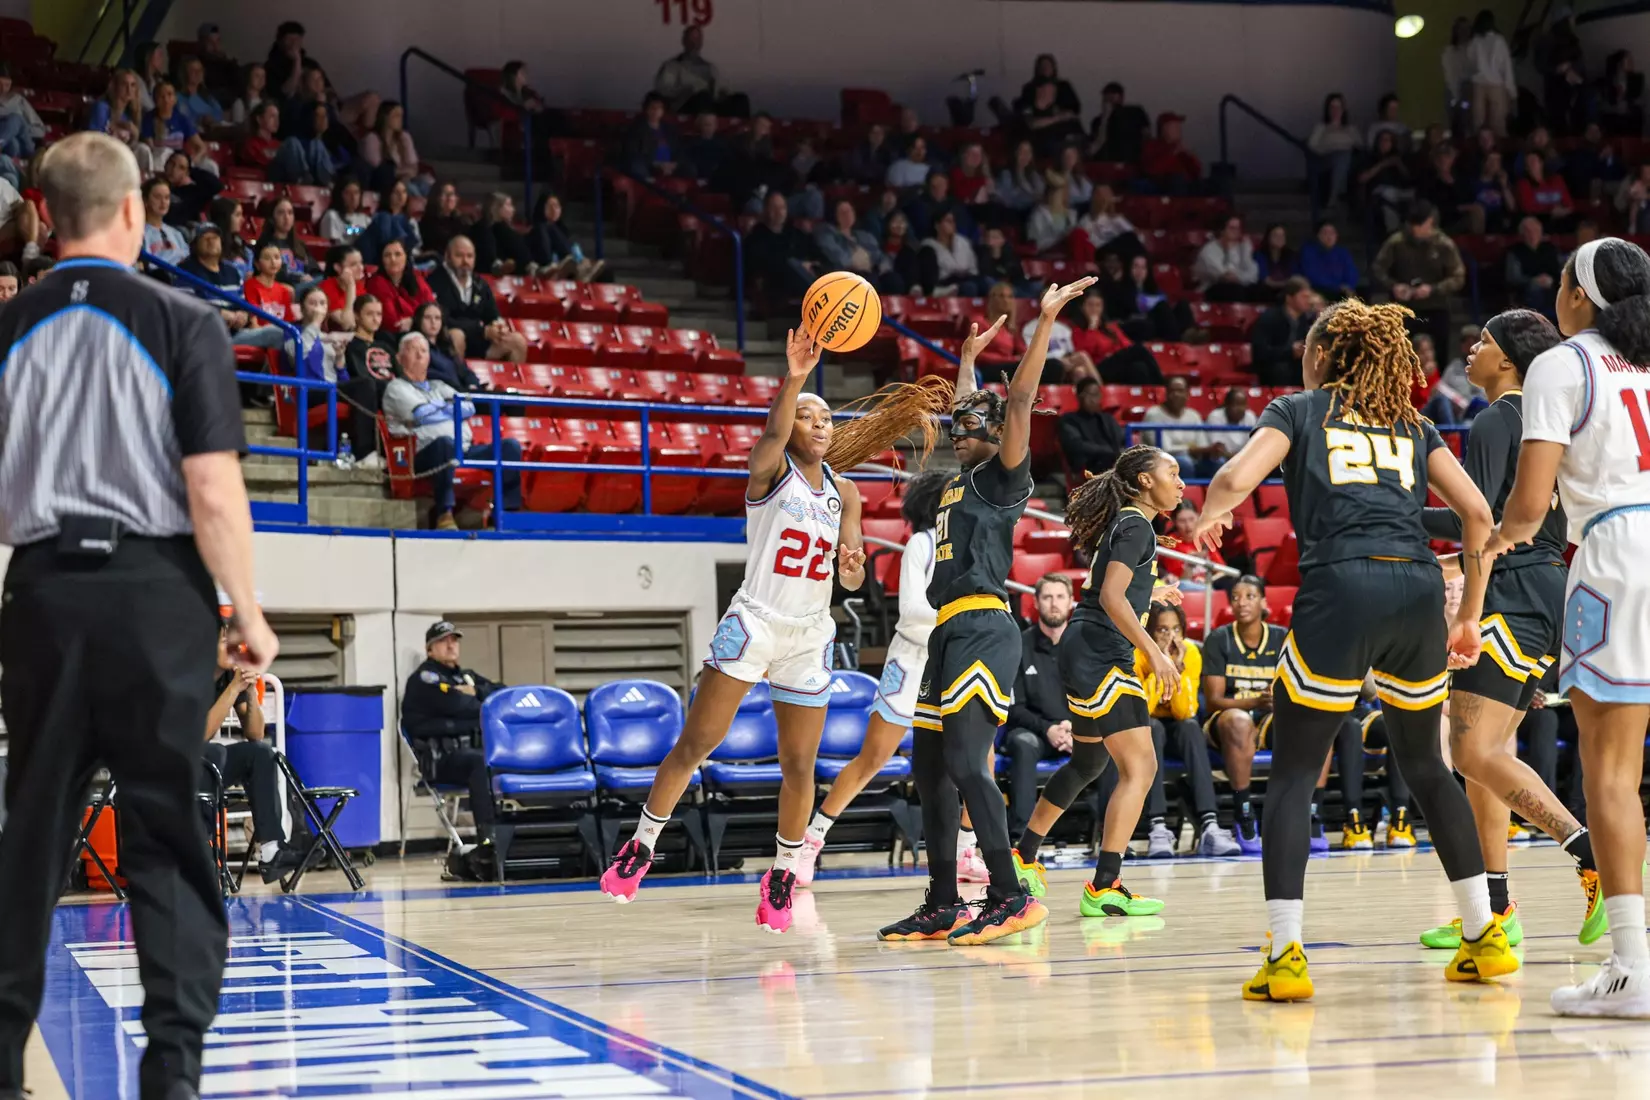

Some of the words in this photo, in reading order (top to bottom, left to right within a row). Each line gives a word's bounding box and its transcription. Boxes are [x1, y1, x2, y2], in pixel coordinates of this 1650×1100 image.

[655, 0, 712, 28] 119
[821, 301, 860, 344] Wilson
[1619, 388, 1650, 472] 1
[1323, 427, 1416, 493] 24
[936, 508, 950, 544] 21
[773, 527, 832, 581] 22
